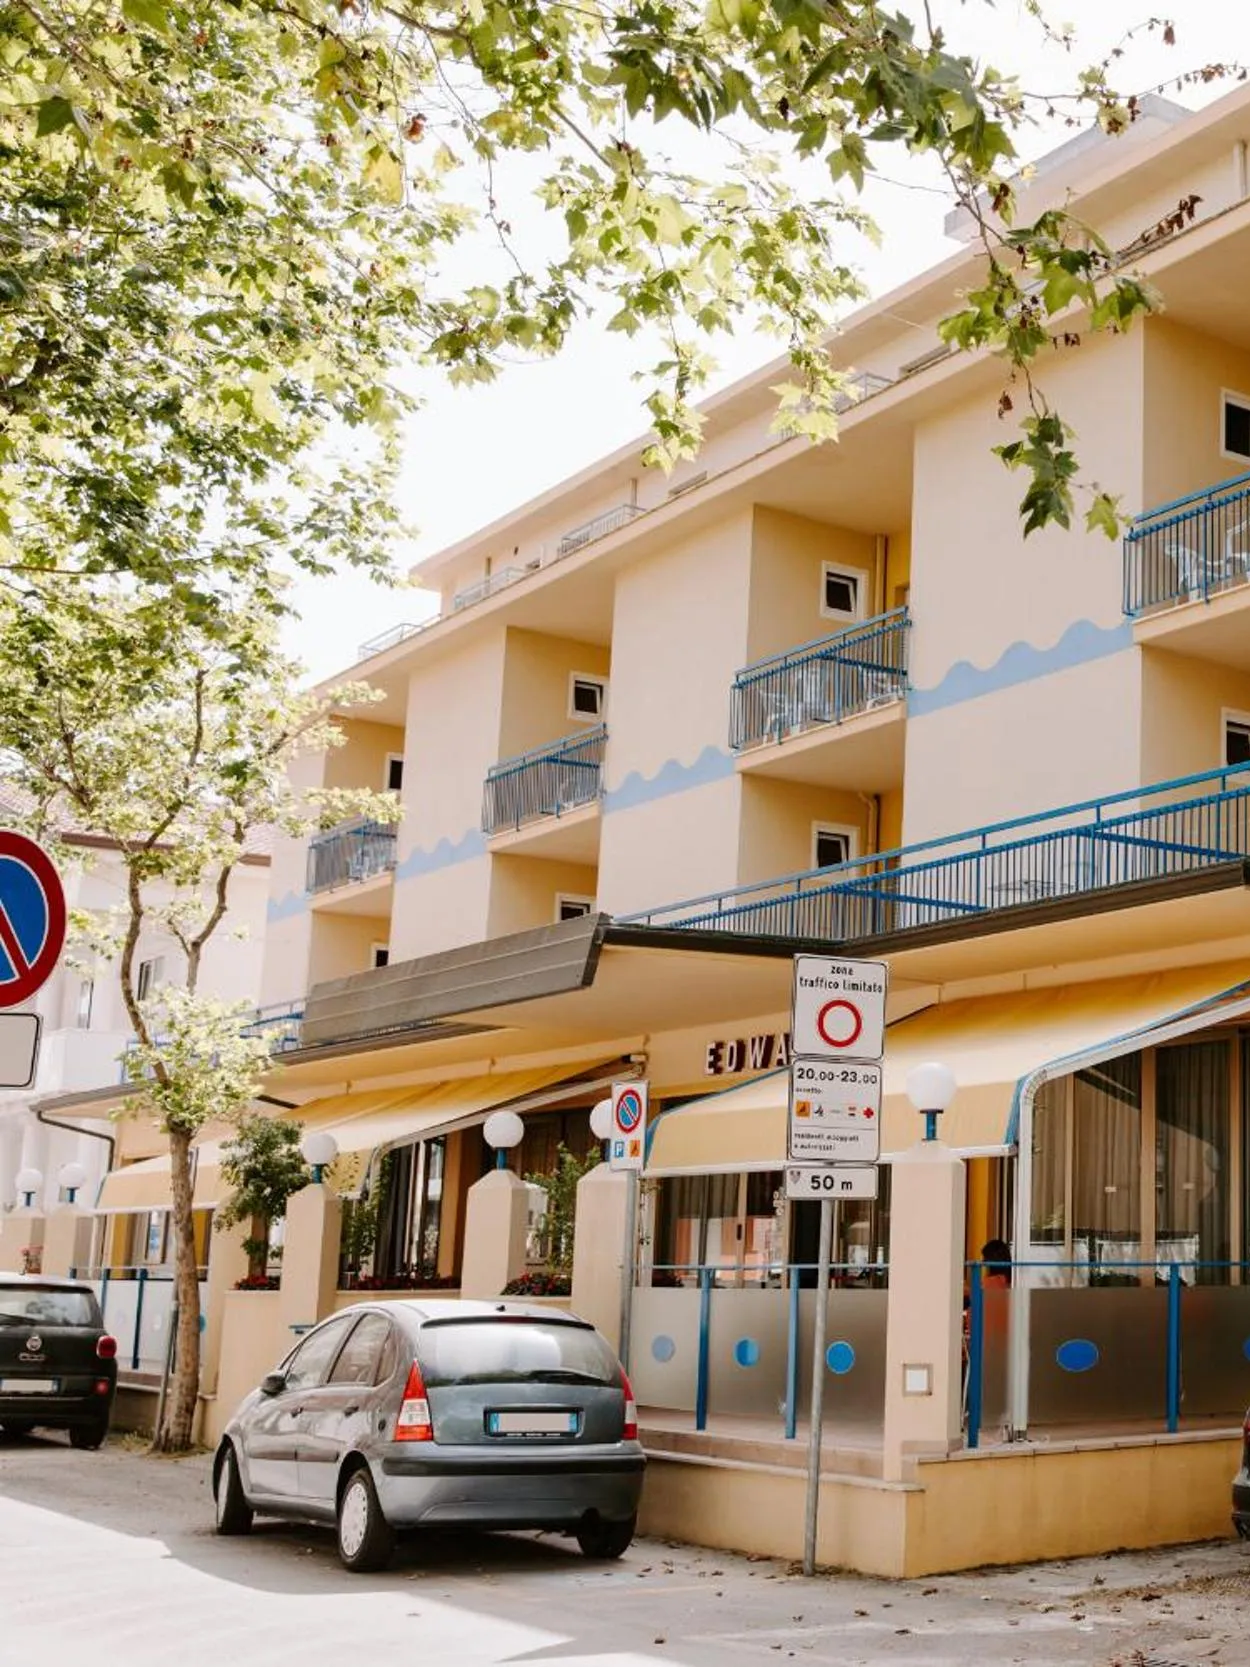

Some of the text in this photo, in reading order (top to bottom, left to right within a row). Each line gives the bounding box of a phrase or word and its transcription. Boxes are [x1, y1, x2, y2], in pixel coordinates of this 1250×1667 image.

[831, 965, 854, 976] zona
[799, 976, 883, 993] traffico limitato
[703, 1032, 790, 1075] EDWA
[811, 1175, 853, 1190] 50 m
